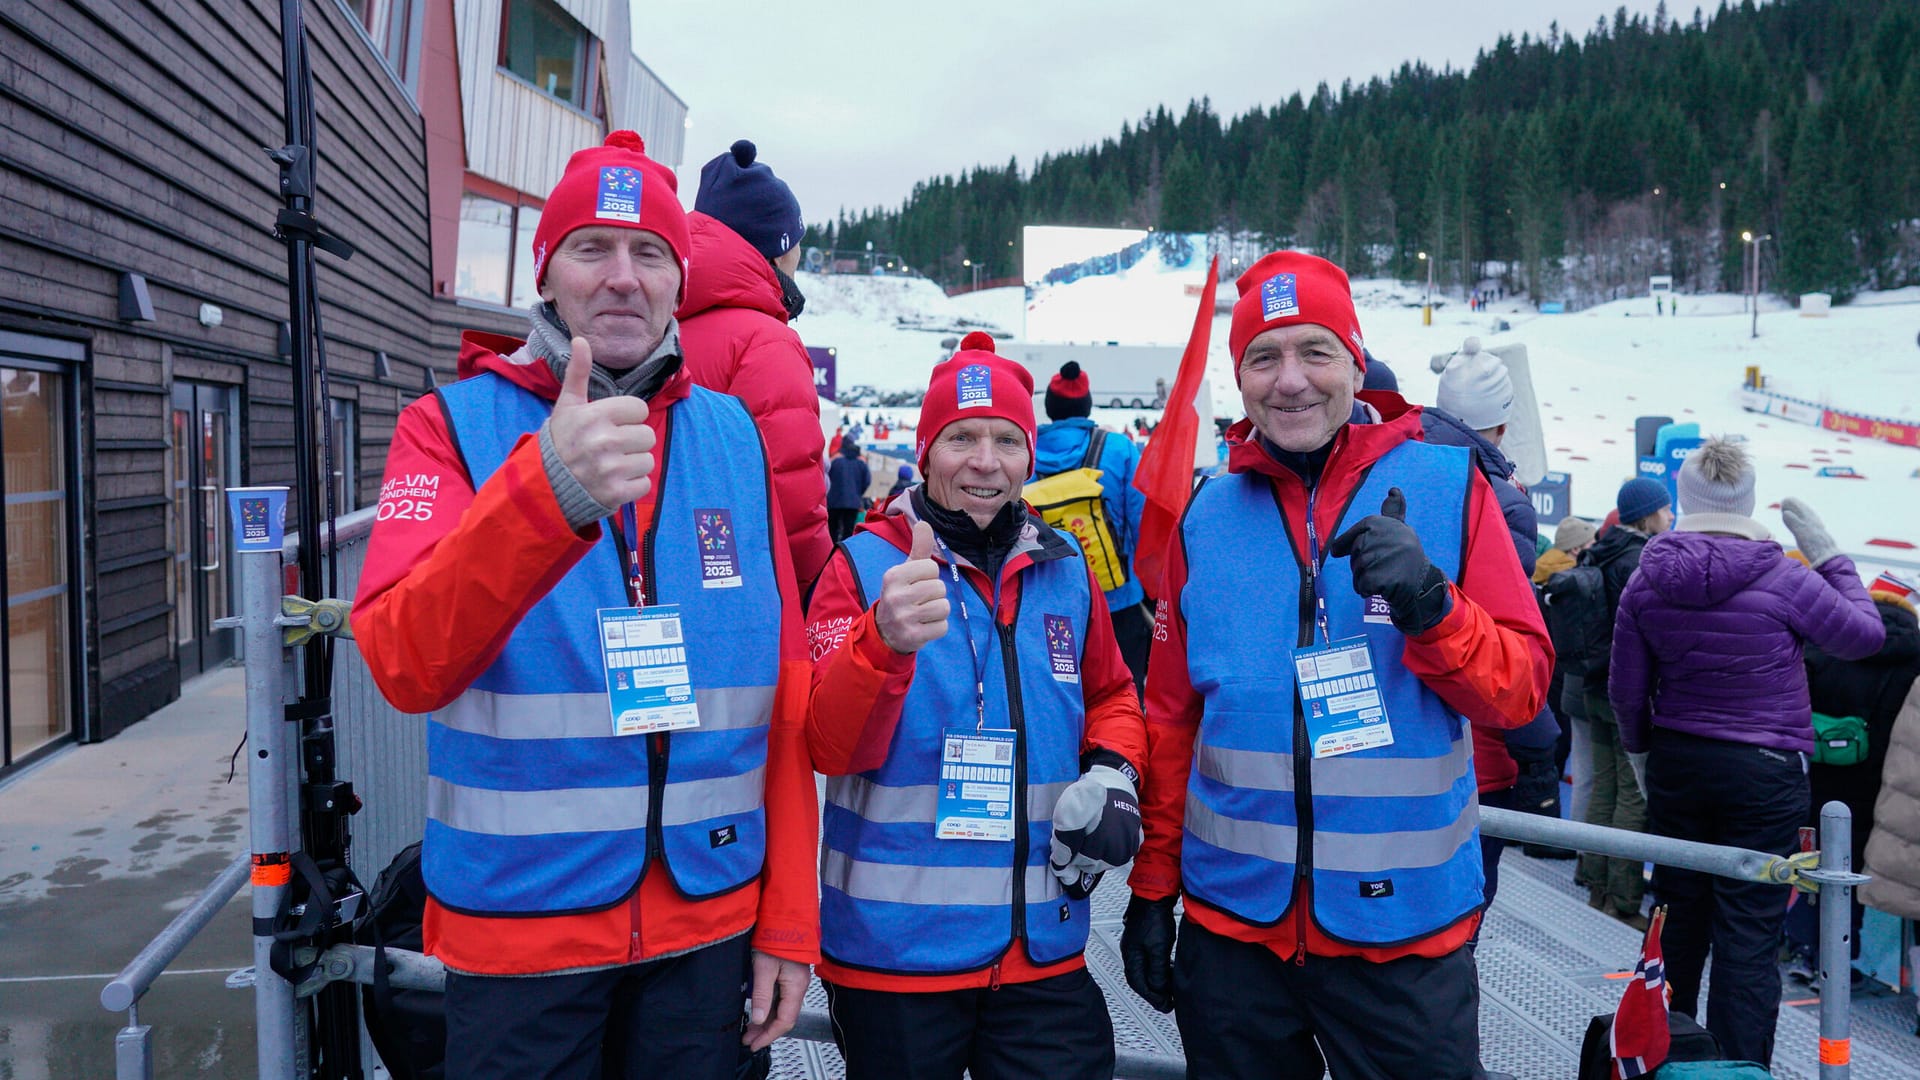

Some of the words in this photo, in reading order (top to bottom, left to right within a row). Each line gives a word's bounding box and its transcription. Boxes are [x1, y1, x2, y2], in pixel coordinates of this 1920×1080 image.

[603, 202, 635, 212] 2025
[1267, 300, 1293, 312] 2025
[962, 391, 988, 400] 2025
[1640, 461, 1666, 475] coop
[381, 488, 436, 500] ONDHEIM
[377, 499, 433, 520] 025
[705, 566, 733, 576] 2025
[1370, 603, 1390, 613] 20
[809, 625, 850, 645] ONDHEIM
[1054, 663, 1074, 672] 2025
